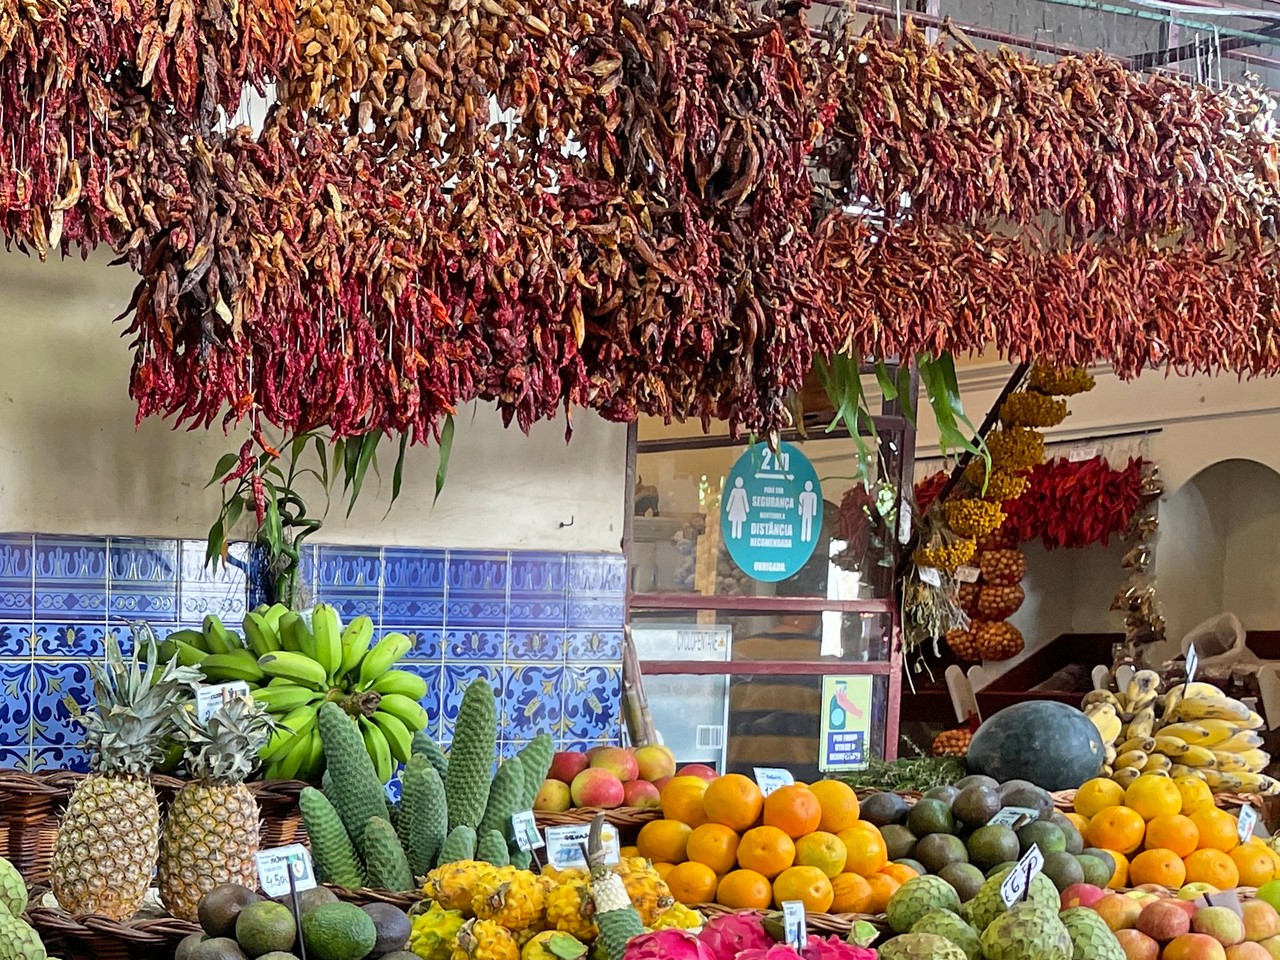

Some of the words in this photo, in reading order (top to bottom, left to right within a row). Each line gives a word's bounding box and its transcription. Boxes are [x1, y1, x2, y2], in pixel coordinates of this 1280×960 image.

[761, 447, 772, 471] 2
[752, 496, 794, 510] SEGURANÇA
[750, 521, 793, 537] DISTÂNCIA
[750, 537, 793, 549] RECOMENDADA
